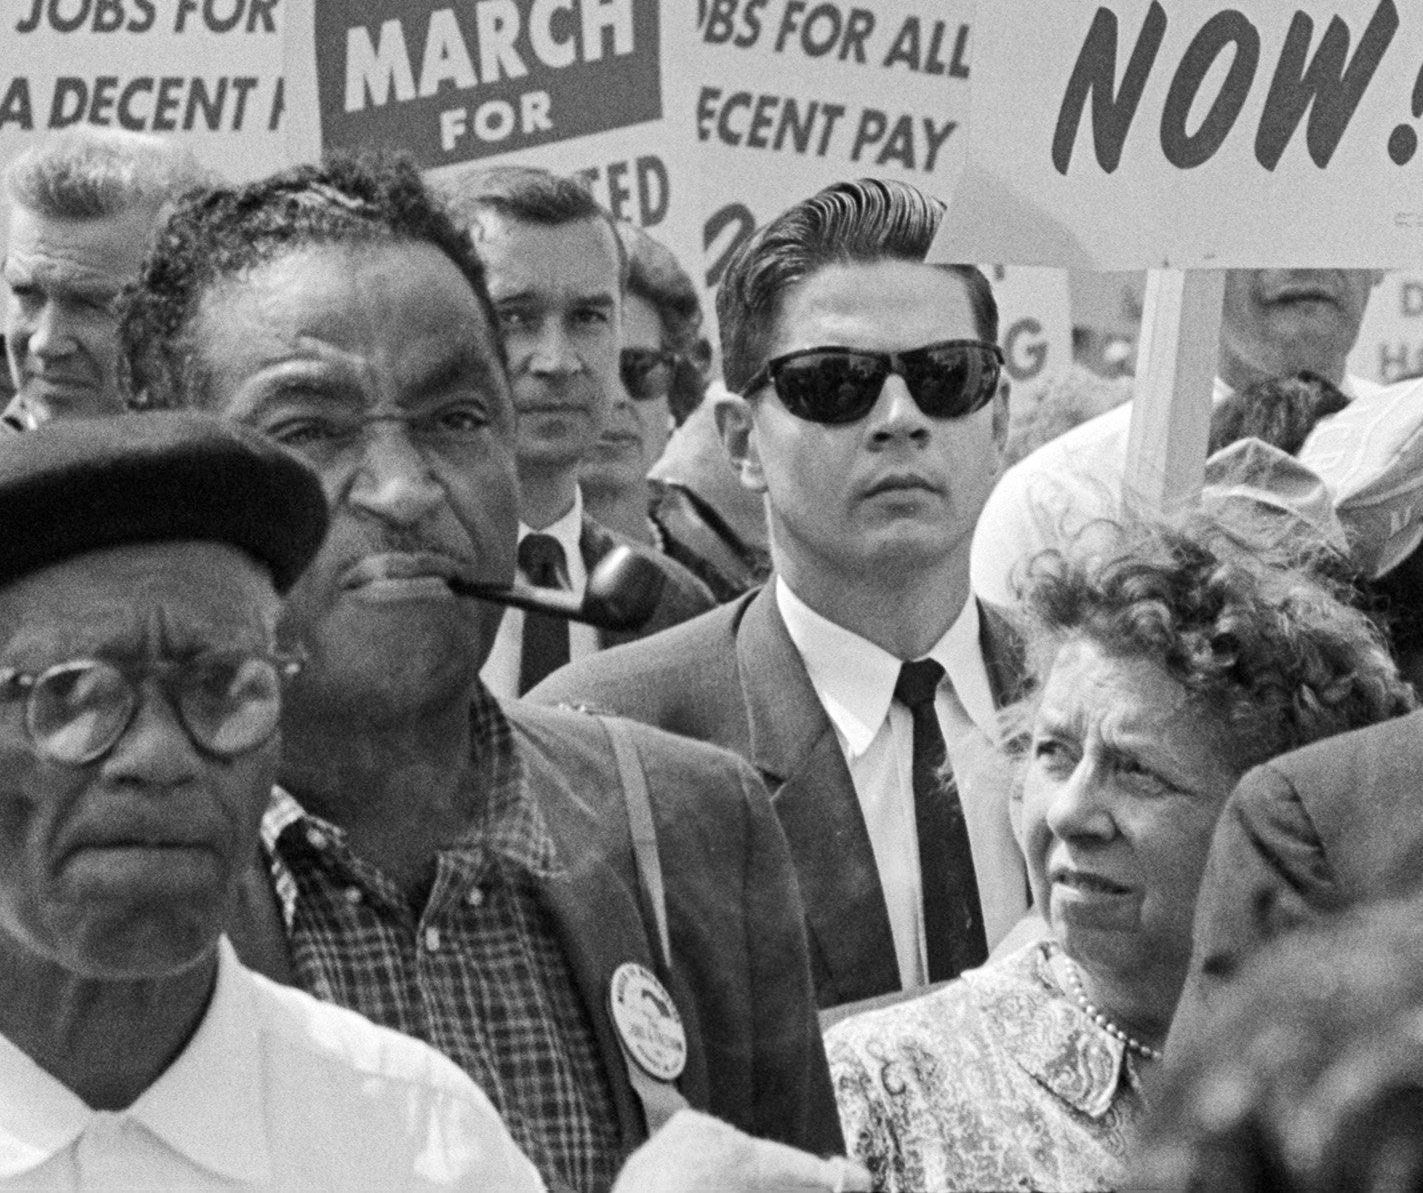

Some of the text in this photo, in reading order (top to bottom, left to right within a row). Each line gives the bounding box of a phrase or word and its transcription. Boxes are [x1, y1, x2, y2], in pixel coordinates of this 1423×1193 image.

[882, 15, 970, 79] ALL
[0, 76, 34, 130] A
[48, 76, 258, 131] DECENT
[441, 91, 553, 151] FOR
[851, 108, 957, 173] PAY
